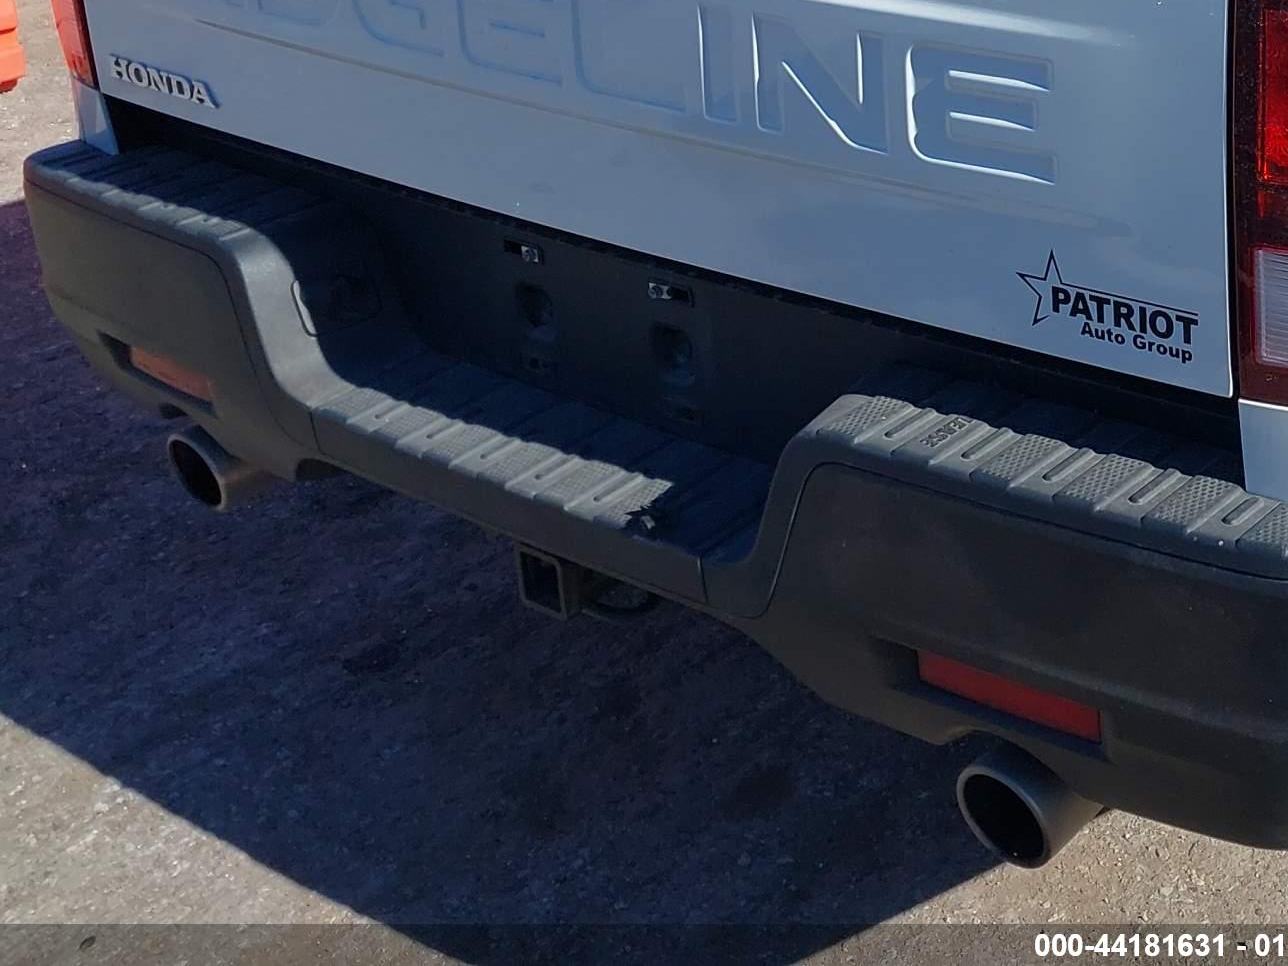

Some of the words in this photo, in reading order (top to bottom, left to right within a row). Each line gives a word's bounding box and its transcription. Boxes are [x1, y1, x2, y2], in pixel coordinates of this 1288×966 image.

[111, 54, 217, 109] HONDA
[1051, 285, 1199, 346] PATRIOT
[1080, 321, 1126, 346] Auto
[1132, 334, 1194, 364] Group
